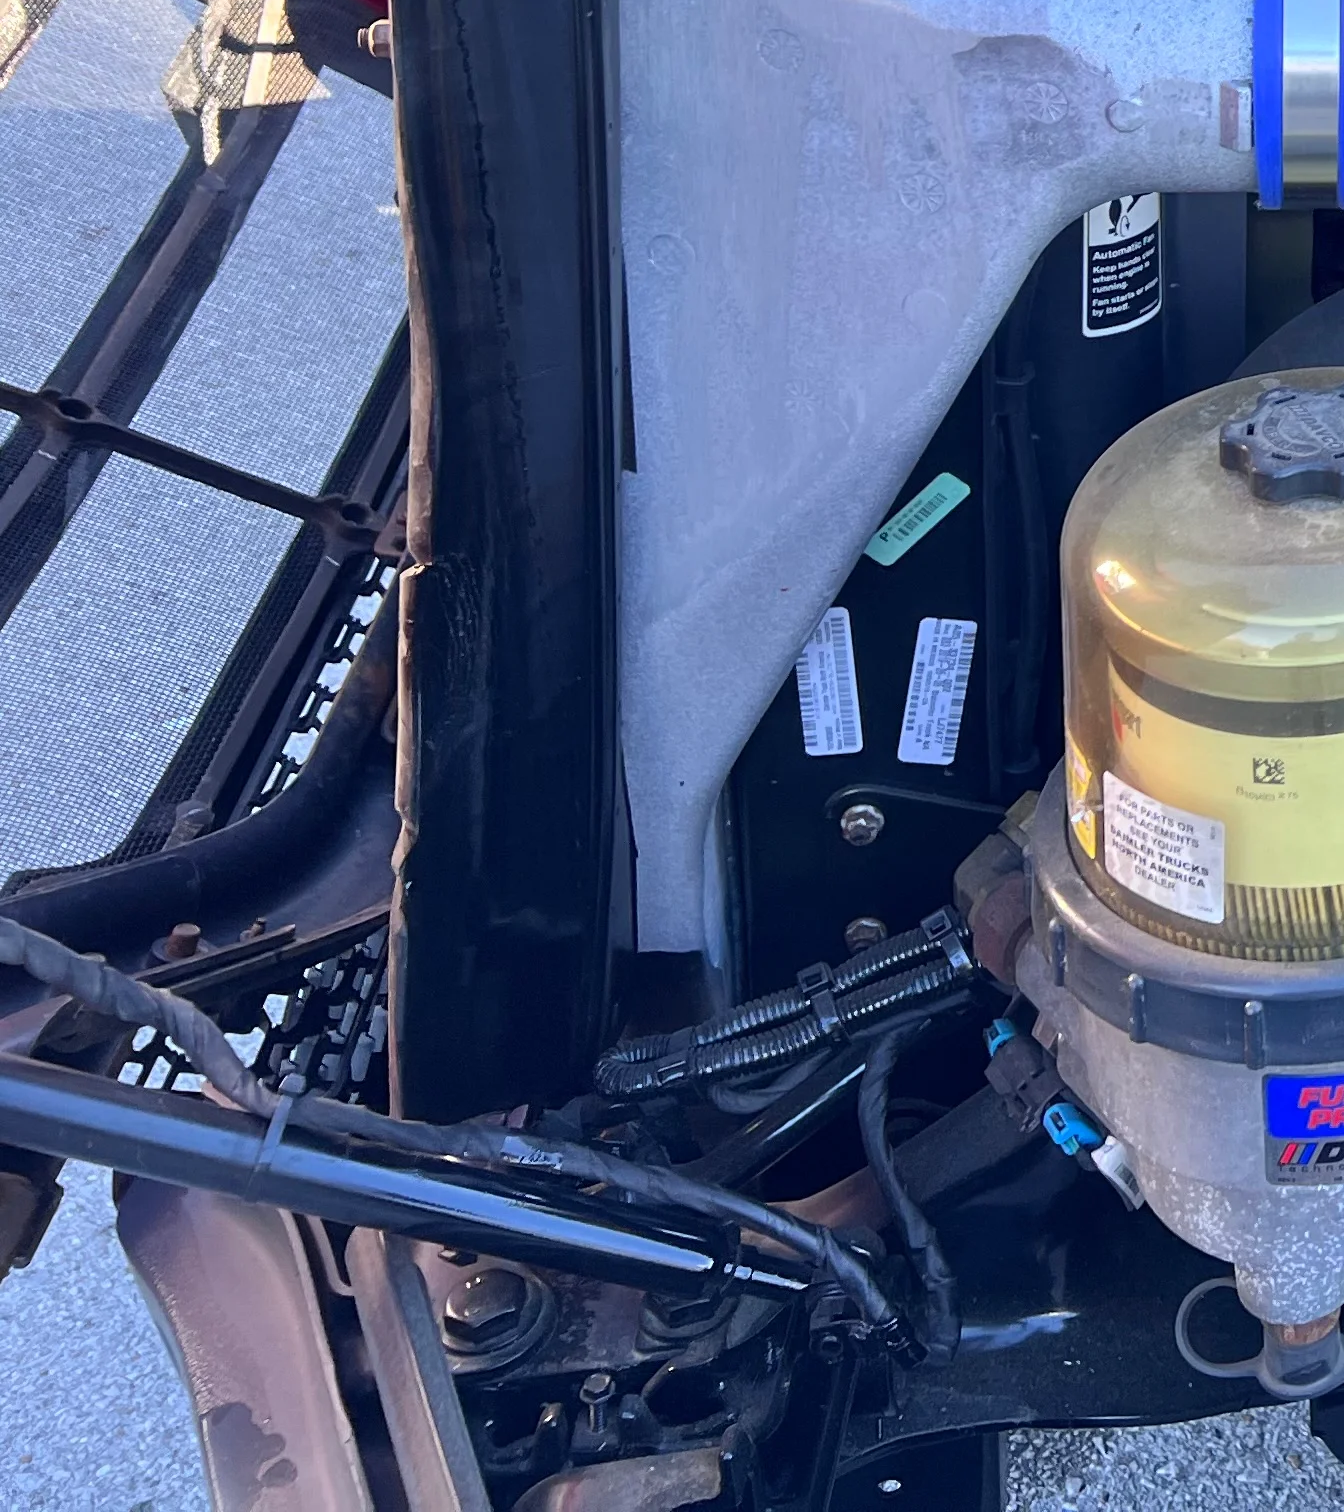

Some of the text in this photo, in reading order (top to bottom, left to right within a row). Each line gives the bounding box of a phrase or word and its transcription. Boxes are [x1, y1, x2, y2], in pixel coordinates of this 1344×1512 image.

[1092, 241, 1142, 261] Automatic
[1092, 265, 1117, 274] Keep
[1092, 274, 1117, 283] when
[1092, 309, 1105, 317] by
[1116, 804, 1200, 849] REPLACEMENTS
[1118, 792, 1194, 833] FOR PARTS OR
[1110, 824, 1209, 876] DAIMLER TRUCKS
[1130, 825, 1182, 855] SEE YOUR
[1112, 838, 1205, 888] NORTH AMERICA
[1134, 865, 1176, 892] DEALER
